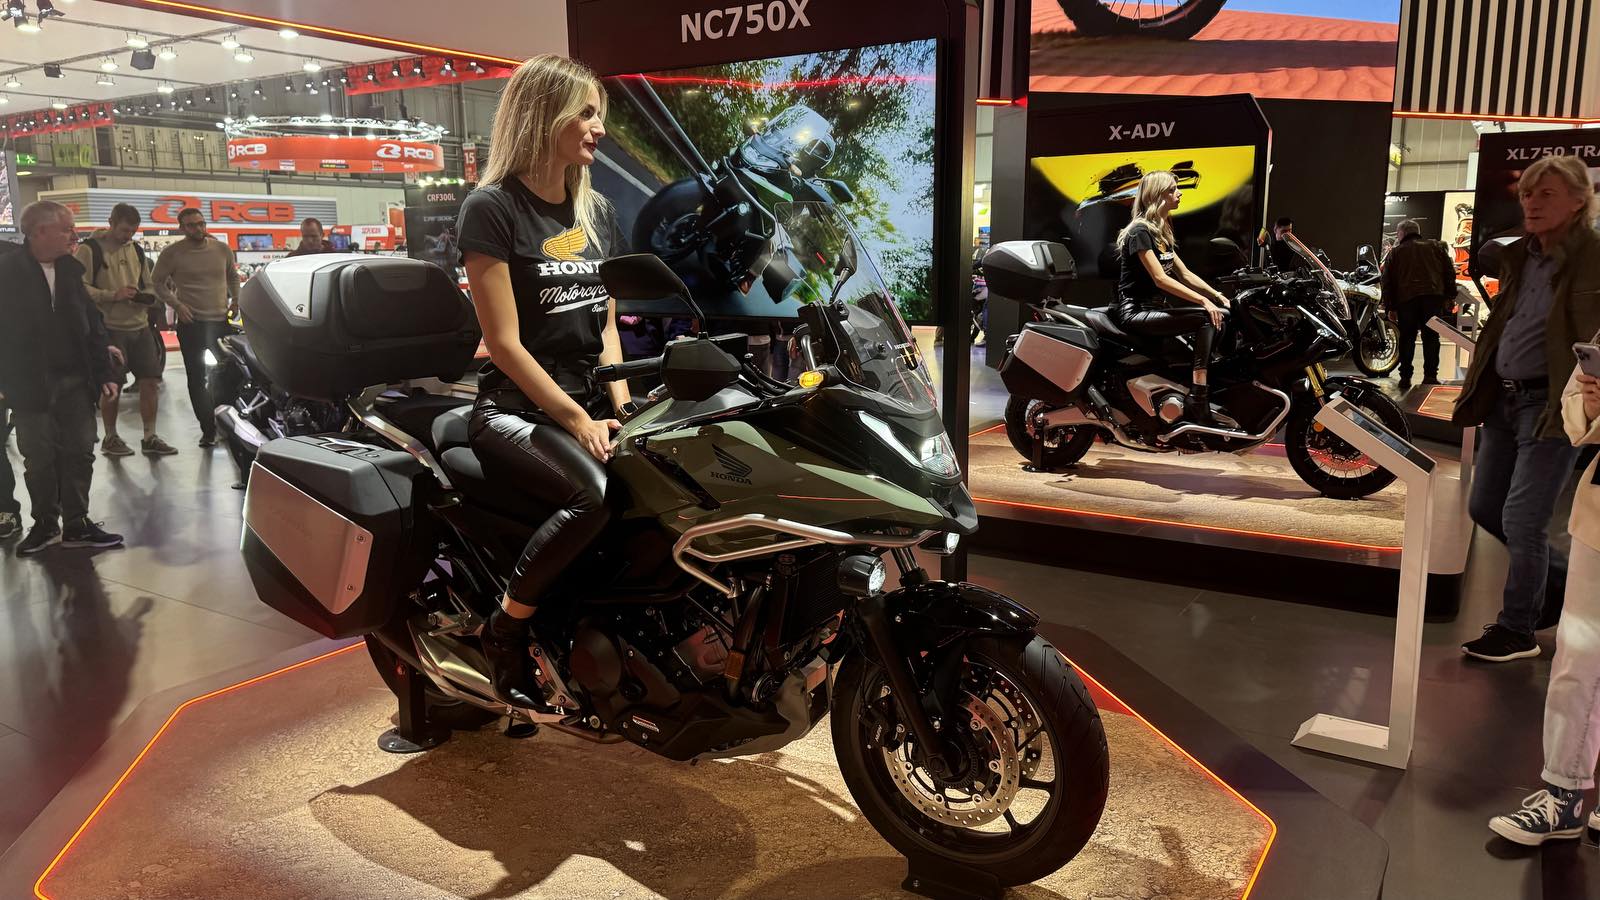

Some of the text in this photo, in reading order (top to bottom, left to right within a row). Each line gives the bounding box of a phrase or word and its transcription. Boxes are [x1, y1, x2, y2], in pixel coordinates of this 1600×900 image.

[681, 0, 811, 43] NC750X
[1108, 121, 1176, 140] X-ADV
[236, 143, 267, 156] RCB
[404, 147, 434, 160] RCB
[1506, 145, 1600, 160] XL750 TR
[464, 152, 475, 164] 15
[427, 193, 456, 202] CRF300L
[211, 200, 295, 223] RCB
[539, 282, 608, 304] Motorcyc
[710, 471, 753, 485] HONDA
